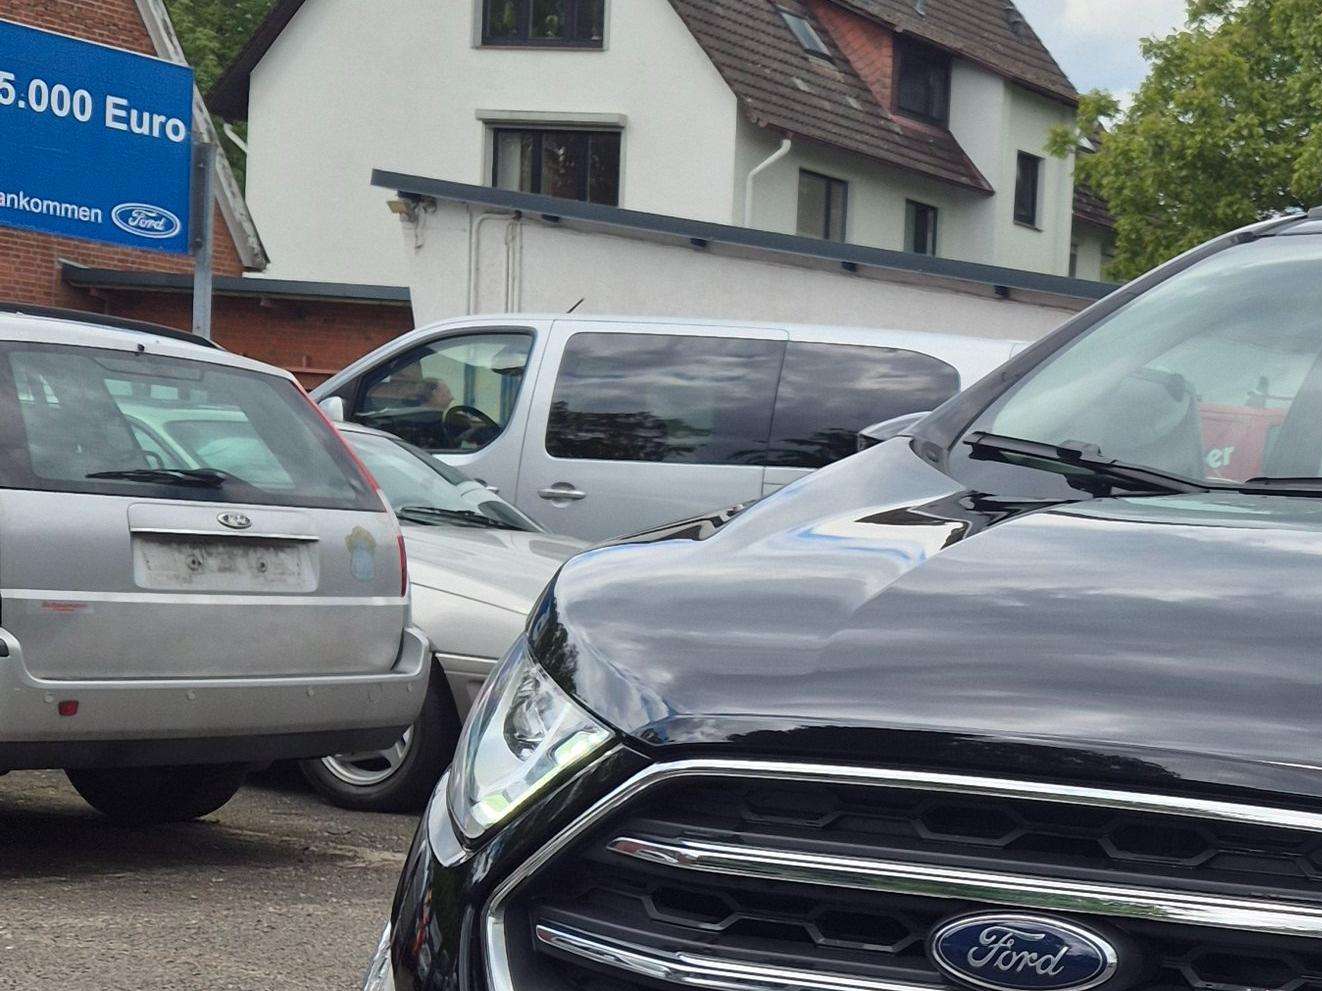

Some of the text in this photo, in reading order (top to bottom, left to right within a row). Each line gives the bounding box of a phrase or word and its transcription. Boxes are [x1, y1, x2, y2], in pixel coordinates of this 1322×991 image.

[105, 94, 187, 143] Euro
[128, 209, 166, 230] Ford
[967, 925, 1069, 976] Ford
